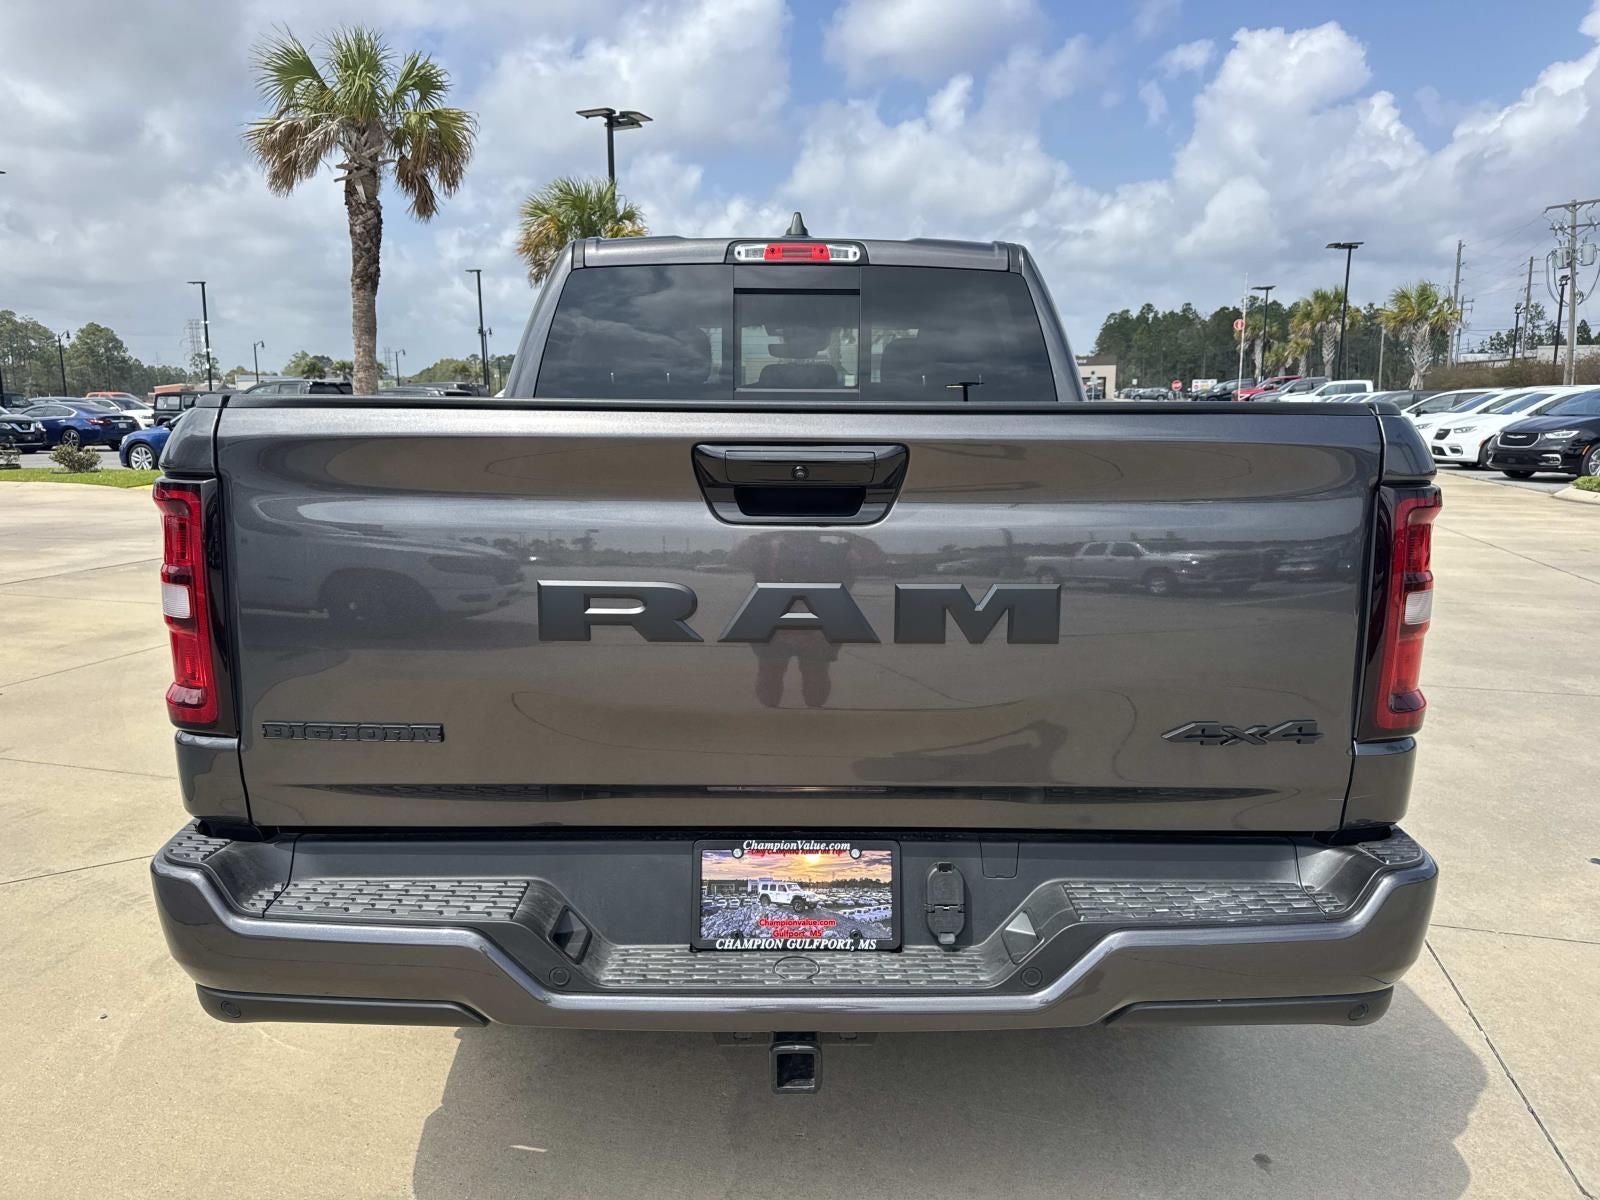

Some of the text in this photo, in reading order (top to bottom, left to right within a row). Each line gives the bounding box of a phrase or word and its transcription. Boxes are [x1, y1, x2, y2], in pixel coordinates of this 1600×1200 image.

[537, 579, 1062, 644] RAM
[262, 721, 444, 742] BIGHORN
[743, 840, 850, 852] ChampionValue.com
[716, 939, 877, 951] CHAMPION GULFPORT, MS
